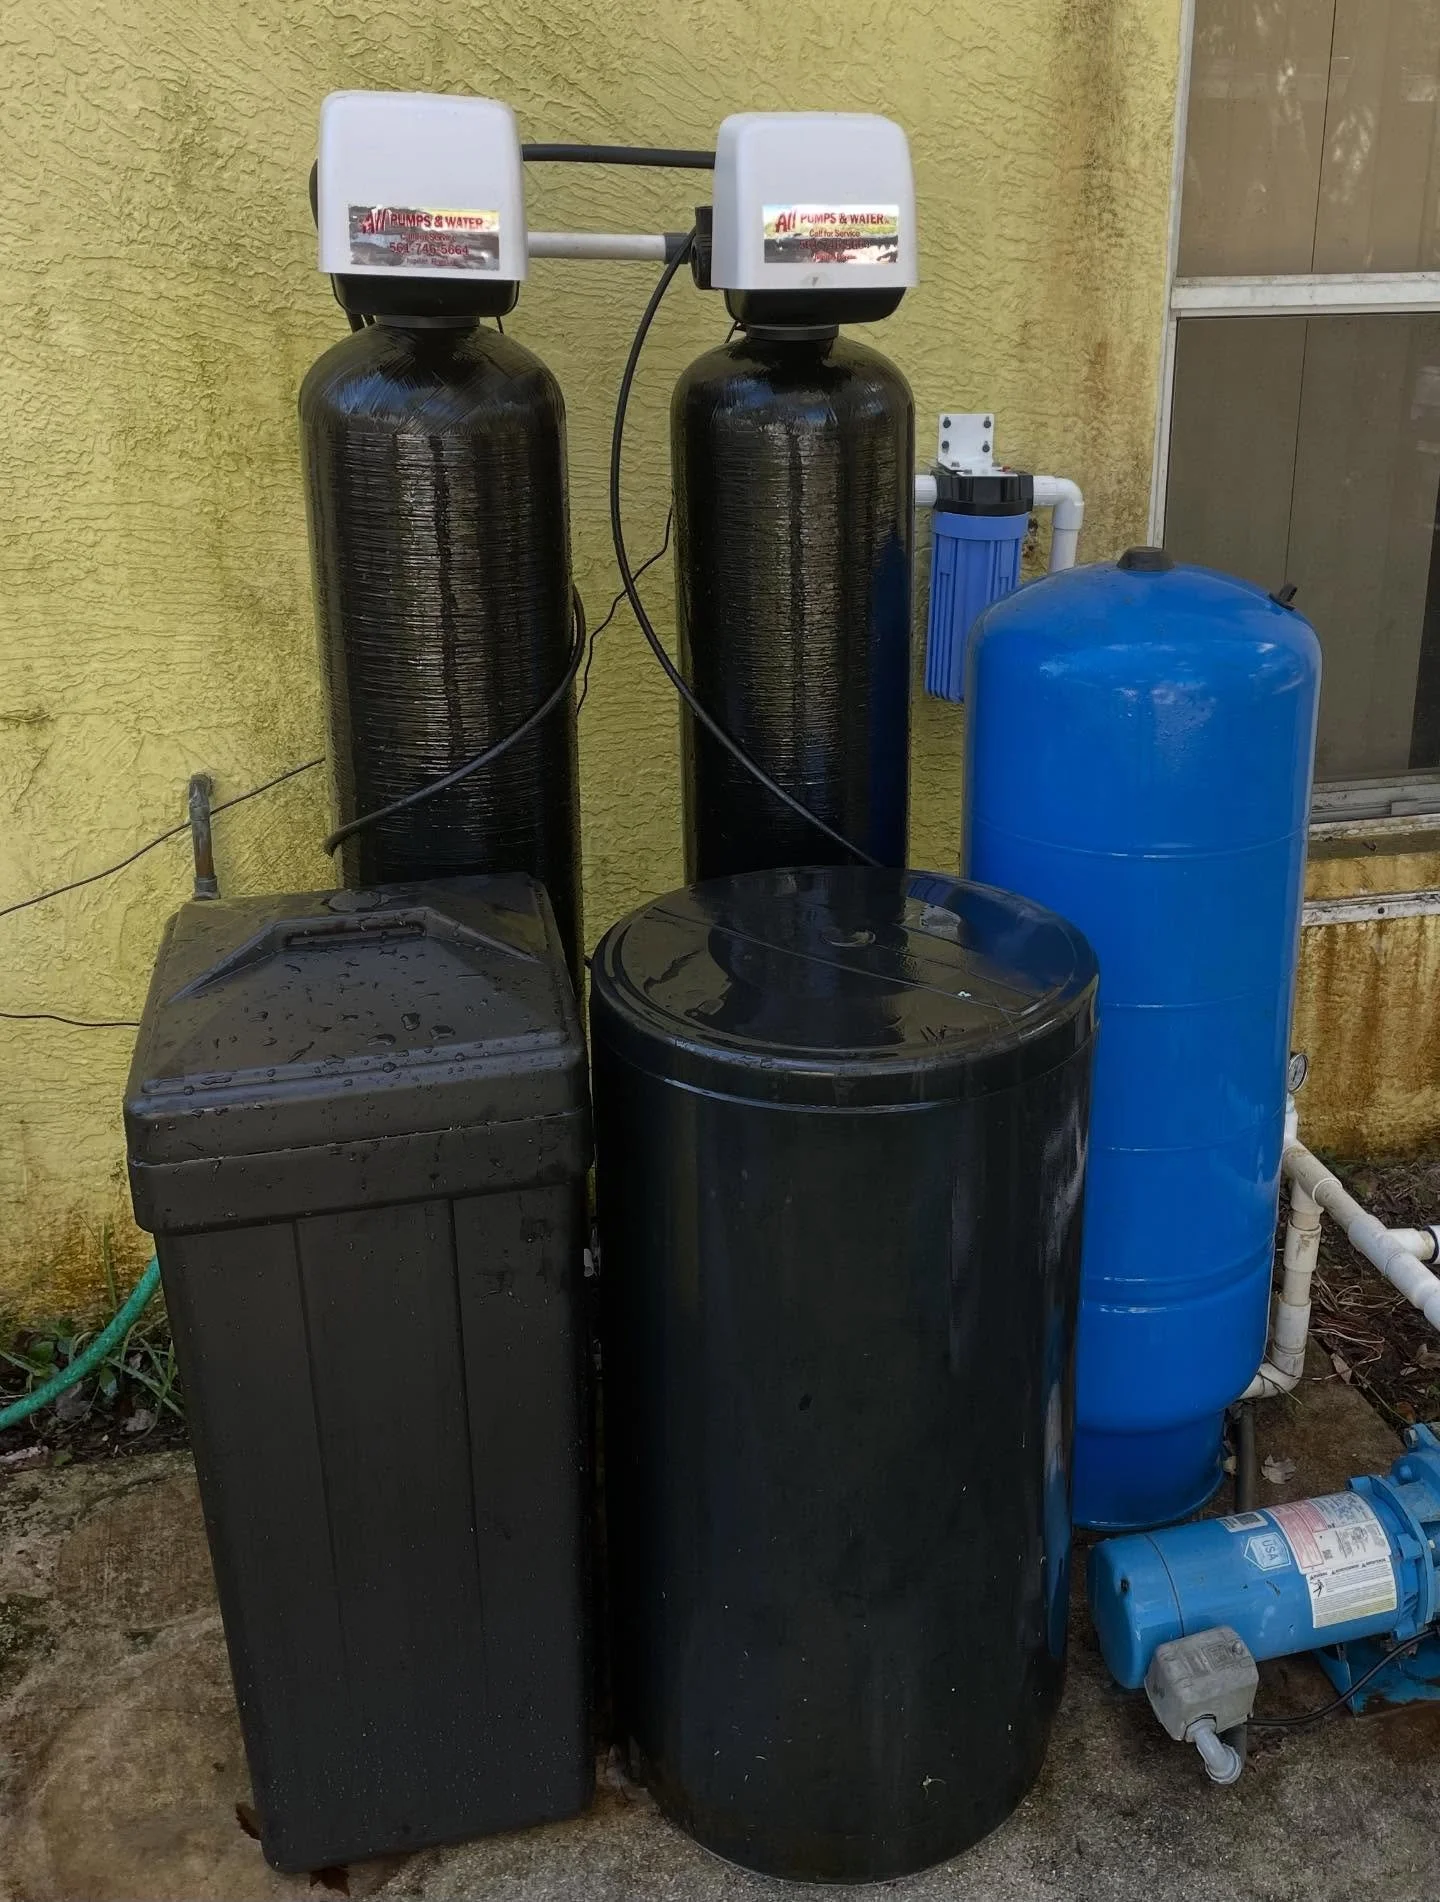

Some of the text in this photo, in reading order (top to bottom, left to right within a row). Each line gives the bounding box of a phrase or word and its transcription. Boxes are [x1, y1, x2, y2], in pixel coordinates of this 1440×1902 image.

[391, 212, 432, 228] PUMPS
[433, 214, 443, 228] &
[445, 215, 484, 230] WATER
[775, 211, 797, 233] All
[800, 212, 837, 224] PUMPS
[839, 212, 848, 225] &
[849, 213, 884, 225] WATER
[809, 228, 861, 238] Call for Service
[1261, 1539, 1280, 1561] USA
